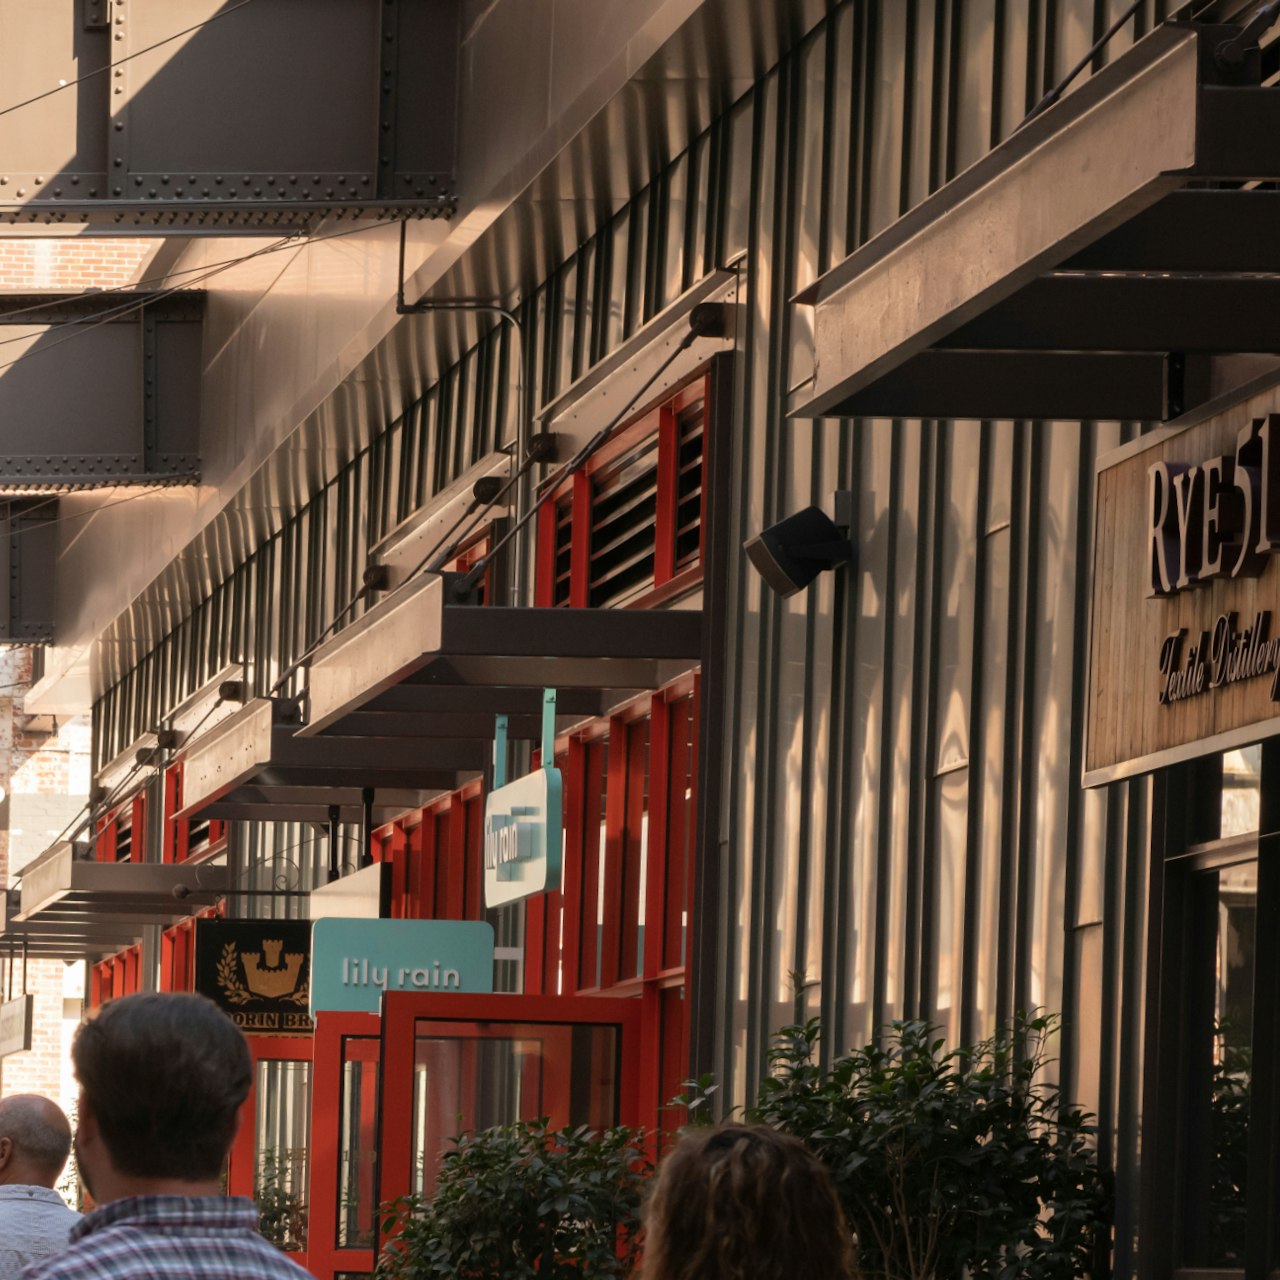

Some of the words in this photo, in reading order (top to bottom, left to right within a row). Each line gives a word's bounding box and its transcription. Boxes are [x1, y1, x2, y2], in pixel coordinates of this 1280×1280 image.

[1145, 456, 1223, 599] RYE
[1159, 629, 1205, 705] Textile
[342, 958, 387, 989] lily
[398, 961, 460, 988] rain
[225, 1012, 279, 1028] ORIN
